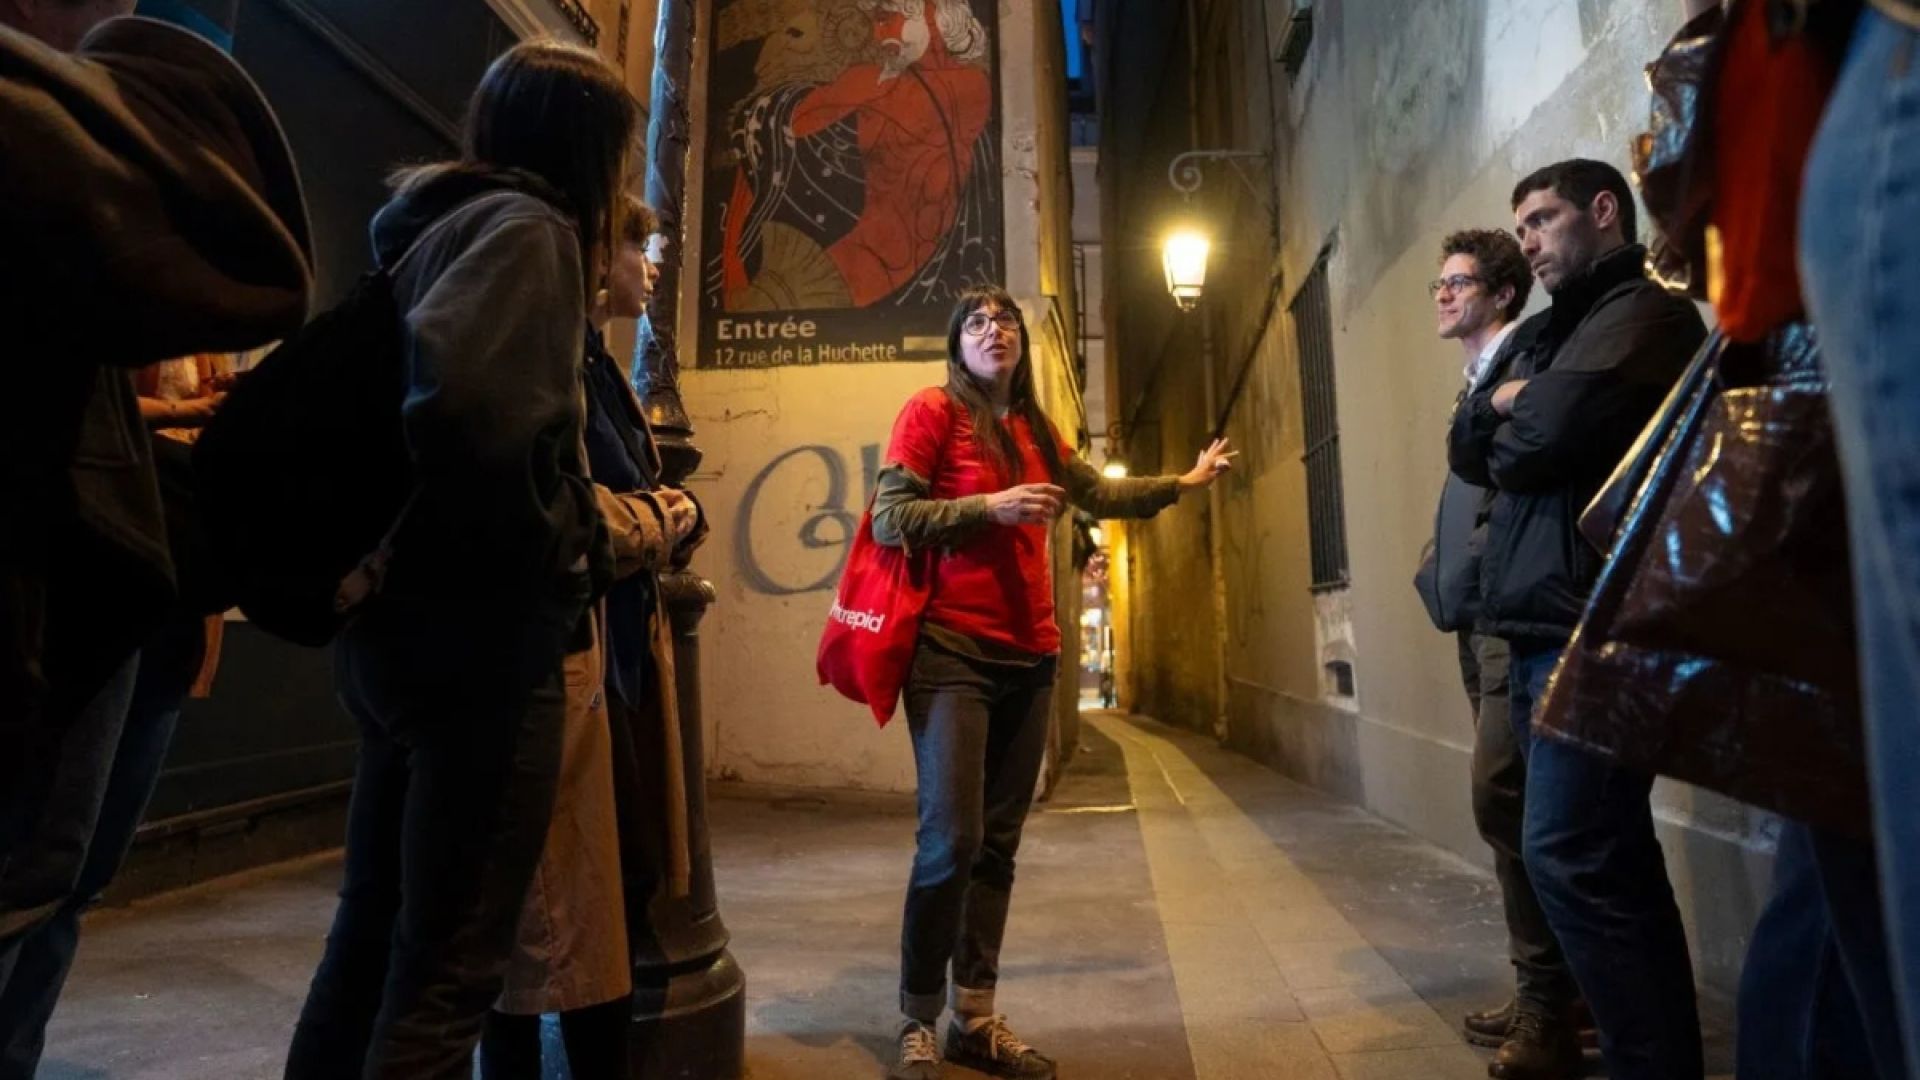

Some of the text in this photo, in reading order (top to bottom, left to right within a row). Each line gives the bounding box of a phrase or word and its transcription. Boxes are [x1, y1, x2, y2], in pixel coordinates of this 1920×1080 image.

[717, 316, 817, 340] Entrée
[716, 343, 897, 365] 12 rue de la Huchette
[831, 605, 885, 633] trepid
